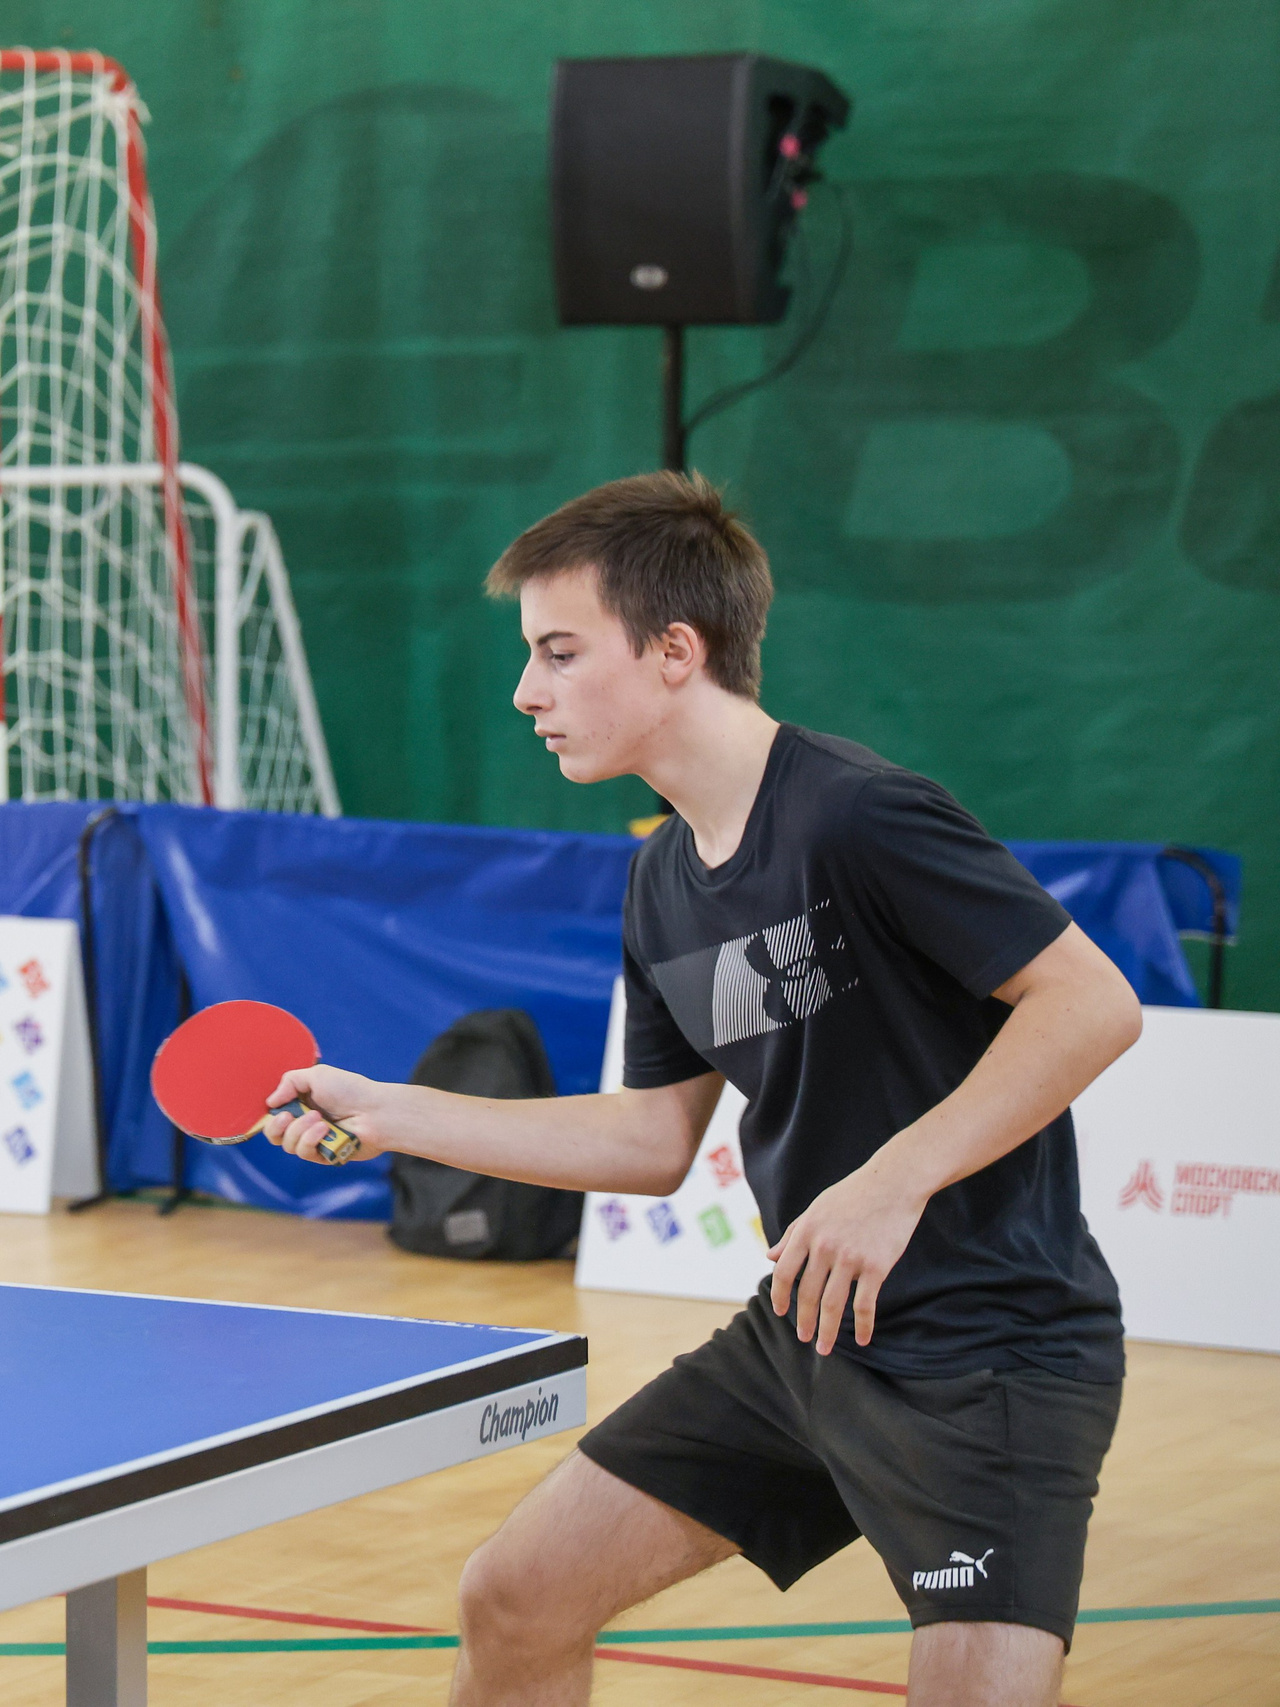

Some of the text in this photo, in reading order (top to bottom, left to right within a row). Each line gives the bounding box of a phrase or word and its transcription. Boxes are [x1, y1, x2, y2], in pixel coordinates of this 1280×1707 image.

[1172, 1191, 1232, 1217] СПОРТ
[480, 1386, 559, 1444] Champion
[913, 1566, 974, 1591] PUMA
